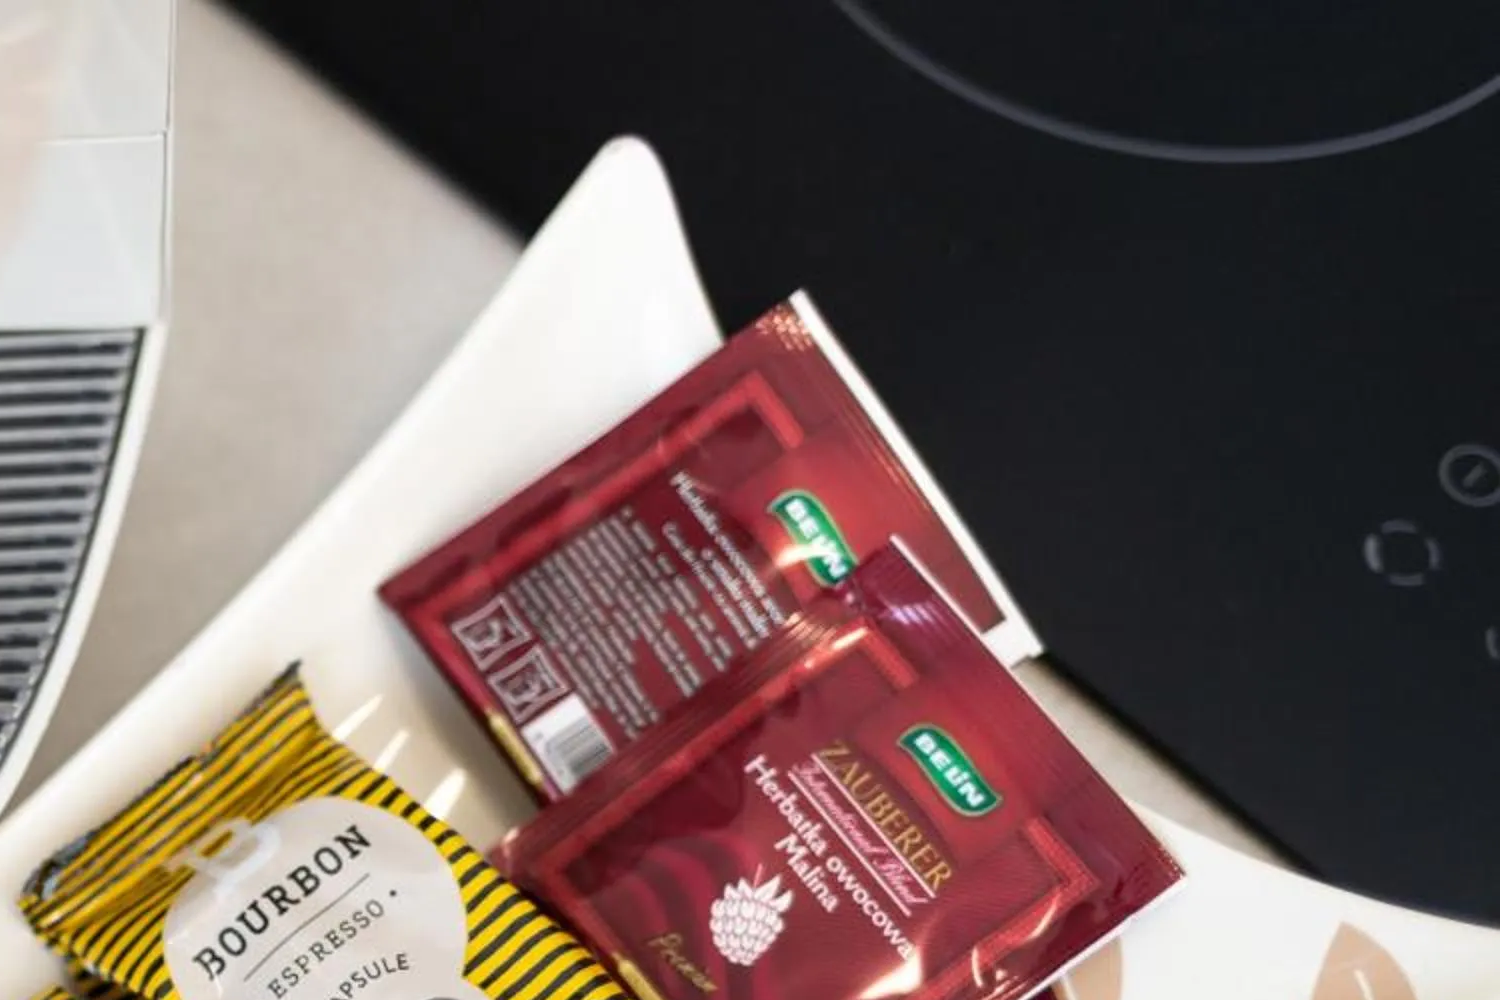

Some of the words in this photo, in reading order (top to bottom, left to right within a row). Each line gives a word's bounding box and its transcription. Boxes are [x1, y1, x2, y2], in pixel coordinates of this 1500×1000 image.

[744, 754, 828, 857] Herbatka
[826, 856, 917, 961] owocowa
[774, 832, 839, 913] Malina
[817, 739, 952, 893] ZAUBERER
[192, 825, 372, 981] BOURBON
[267, 898, 387, 1000] ESPRESSO
